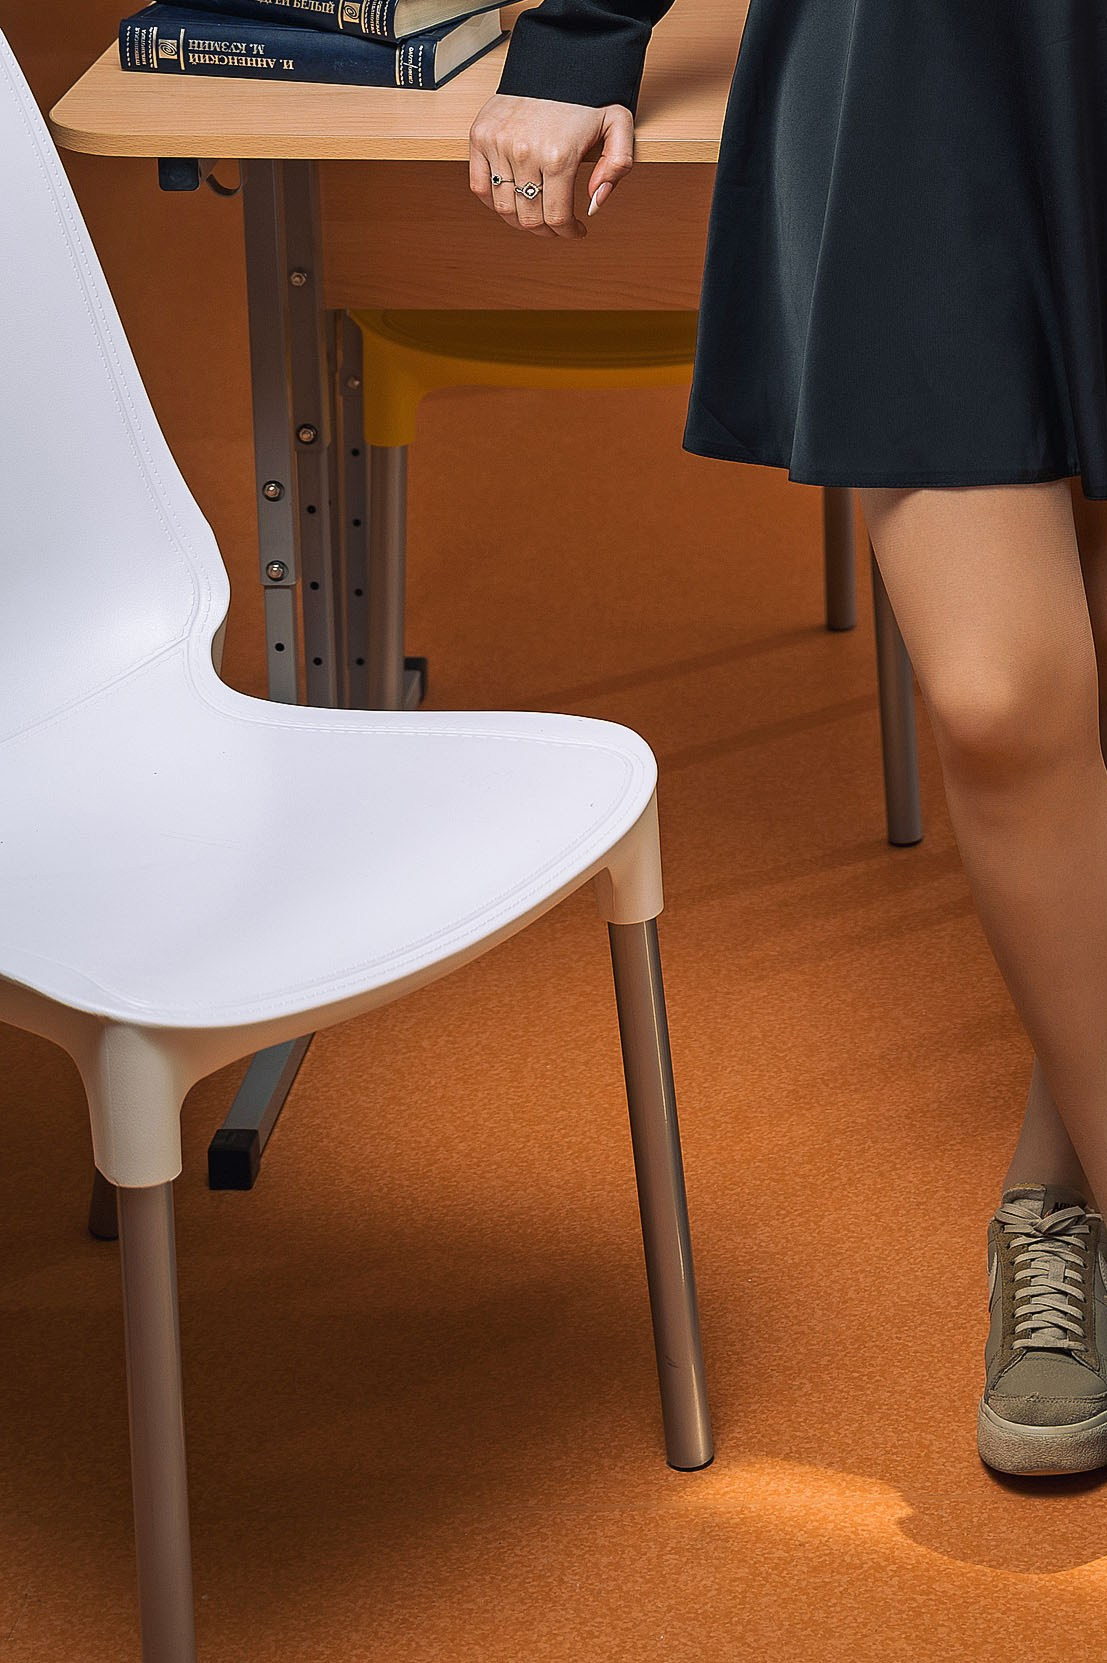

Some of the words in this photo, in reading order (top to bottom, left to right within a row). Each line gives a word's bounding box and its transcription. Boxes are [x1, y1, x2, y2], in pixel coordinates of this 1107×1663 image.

[187, 39, 246, 54] КУЗМИН
[249, 43, 265, 55] М.
[188, 52, 277, 69] АННЕНСКИЙ
[279, 58, 294, 70] И.
